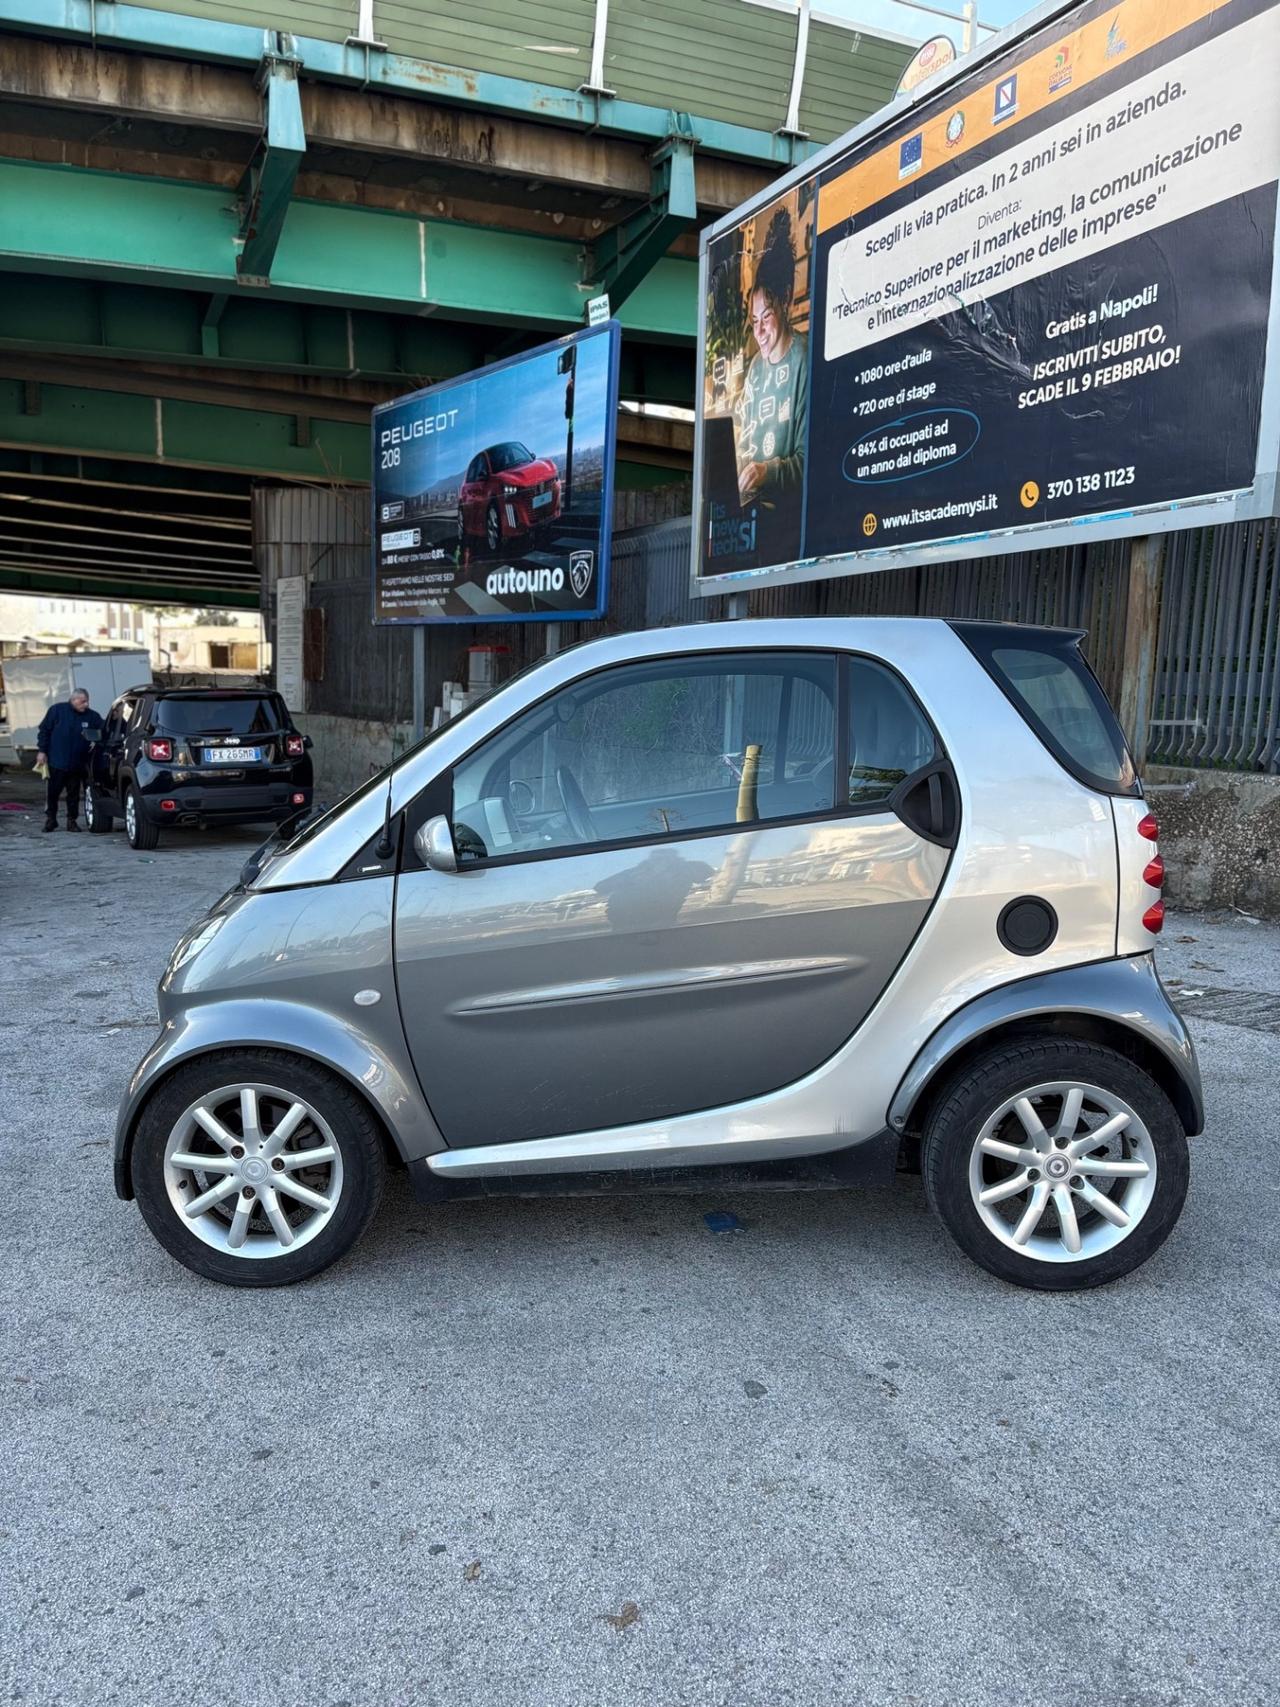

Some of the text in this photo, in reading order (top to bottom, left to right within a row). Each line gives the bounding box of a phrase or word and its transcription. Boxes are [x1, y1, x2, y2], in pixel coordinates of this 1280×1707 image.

[865, 79, 1187, 257] Scegli la via pratica. In 2 anni sei in azienda.
[884, 261, 943, 299] Superiore
[946, 249, 969, 276] per
[972, 238, 980, 259] il
[983, 204, 1067, 251] marketing,
[1071, 193, 1085, 215] la
[1089, 122, 1243, 205] comunicazione
[977, 199, 1022, 230] Diventa:
[867, 184, 1167, 330] e l'internazionalizzazione delle imprese"
[1045, 283, 1159, 339] Gratis a Napoli!
[860, 348, 932, 385] 1080 ore d'aula
[1033, 324, 1167, 381] ISCRIVITI SUBITO,
[1018, 345, 1182, 409] SCADE IL 9 FEBBRAIO!
[858, 381, 936, 416] 720 ore di stage
[381, 409, 459, 448] PEUGEOT
[857, 419, 949, 457] 84% di occupati ad
[381, 447, 400, 469] 208
[857, 442, 957, 477] un anno dal diploma
[1047, 466, 1136, 499] 370 138 1123
[882, 493, 998, 529] www.itsacademysi.it
[486, 567, 564, 595] autouno
